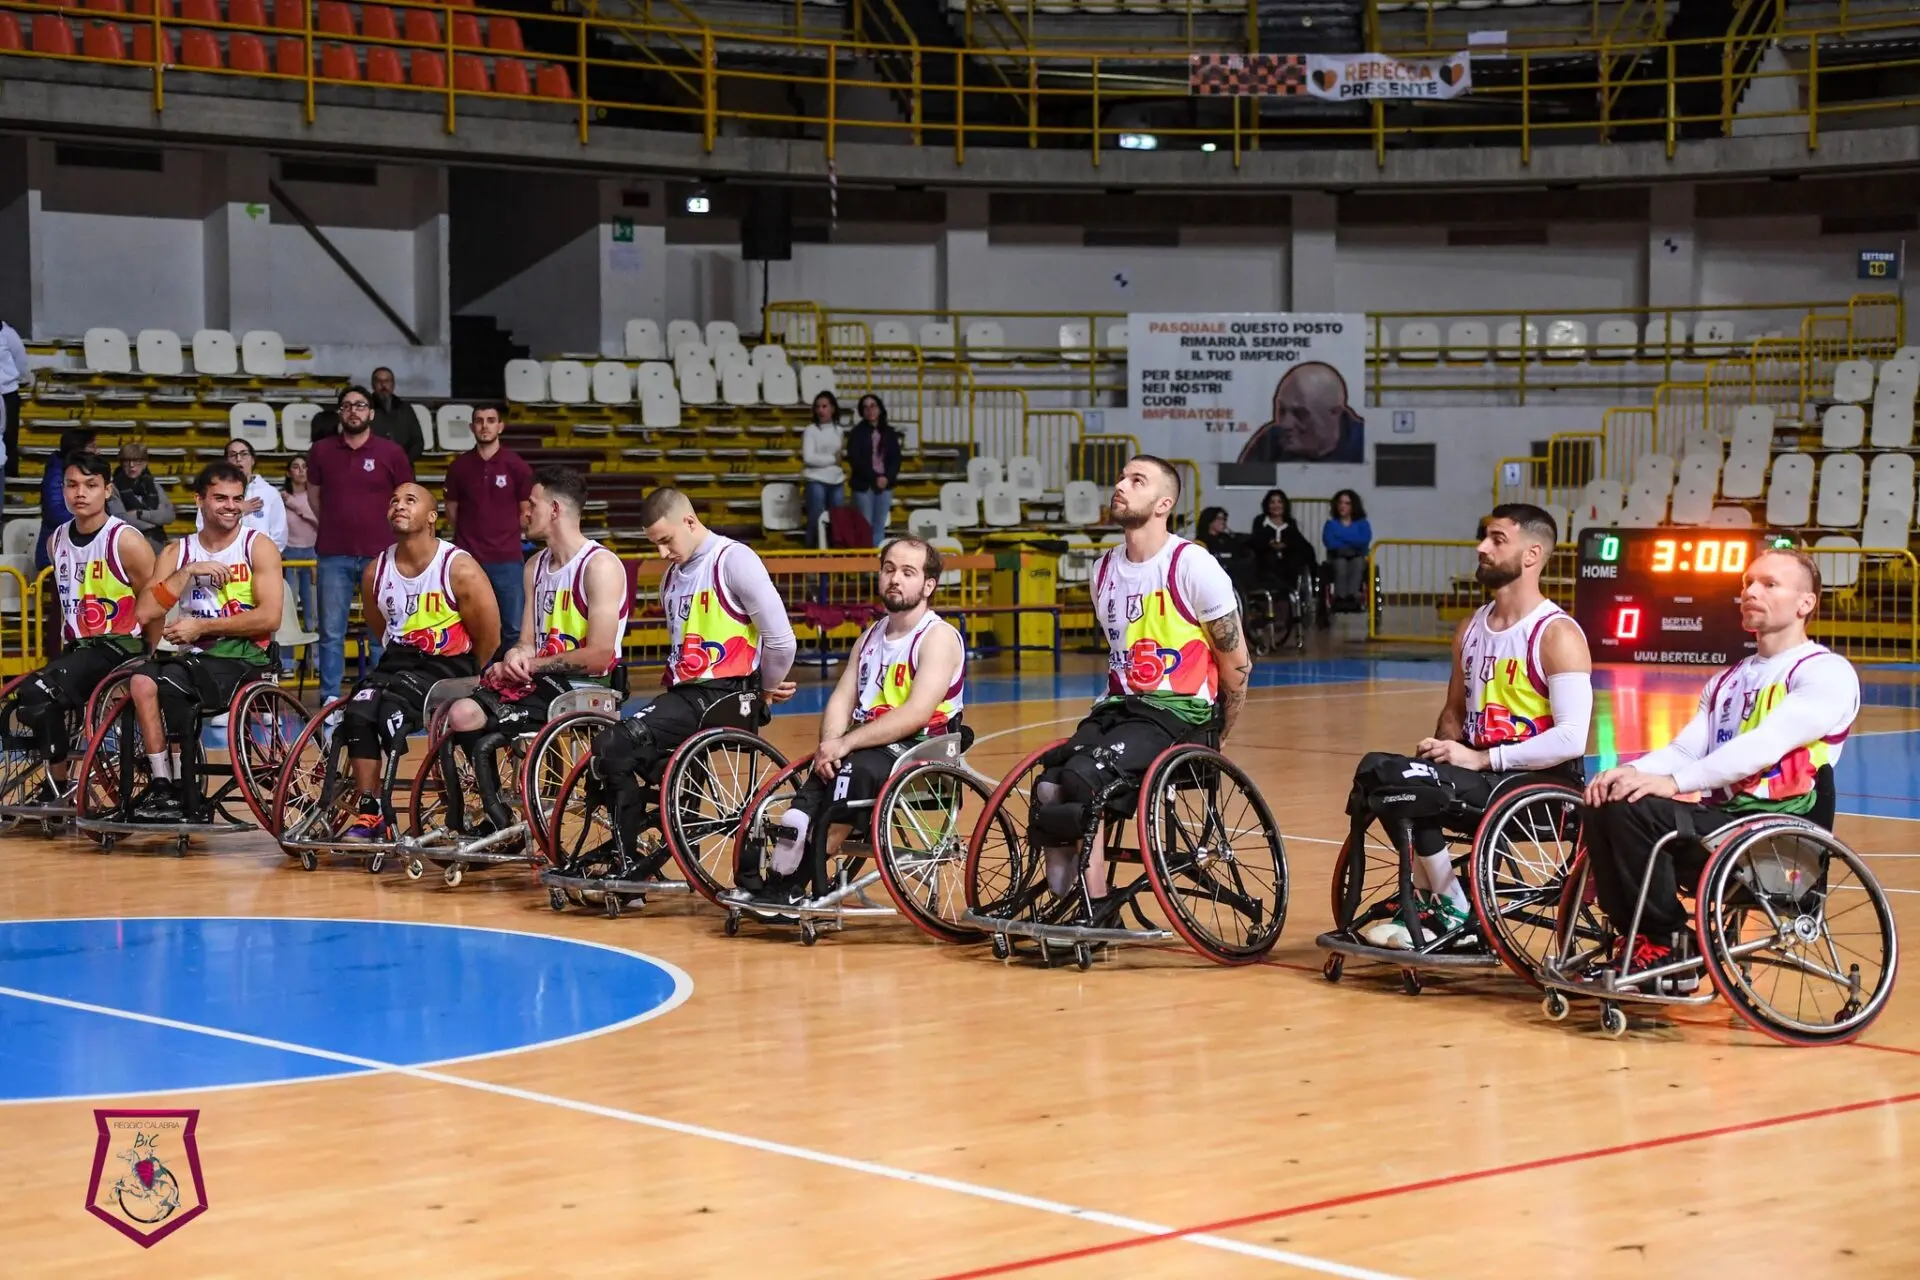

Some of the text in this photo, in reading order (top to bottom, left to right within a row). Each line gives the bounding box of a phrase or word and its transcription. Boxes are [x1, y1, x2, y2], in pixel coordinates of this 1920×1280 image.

[1340, 82, 1438, 97] PRESENTE
[1149, 322, 1343, 334] PASQUALE QUESTO POSTO
[1180, 333, 1311, 347] RIMARRÀ SEMPRE
[1191, 350, 1300, 361] IL TUO IMPERO!
[1142, 369, 1233, 381] PER SEMPRE
[1142, 383, 1222, 393] NEI NOSTRI
[1142, 396, 1187, 406] CUORI
[1142, 408, 1234, 420] IMPERATORE
[1601, 537, 1748, 573] 0 3:00
[91, 561, 103, 579] 21
[230, 564, 249, 583] 20
[1582, 565, 1617, 579] HOME
[425, 592, 440, 613] 17
[561, 591, 570, 611] 11
[700, 591, 709, 614] 9
[1617, 608, 1641, 639] 0
[1634, 650, 1727, 664] WWW.BERTELE.EU
[894, 663, 906, 687] 8
[1505, 659, 1518, 686] 4
